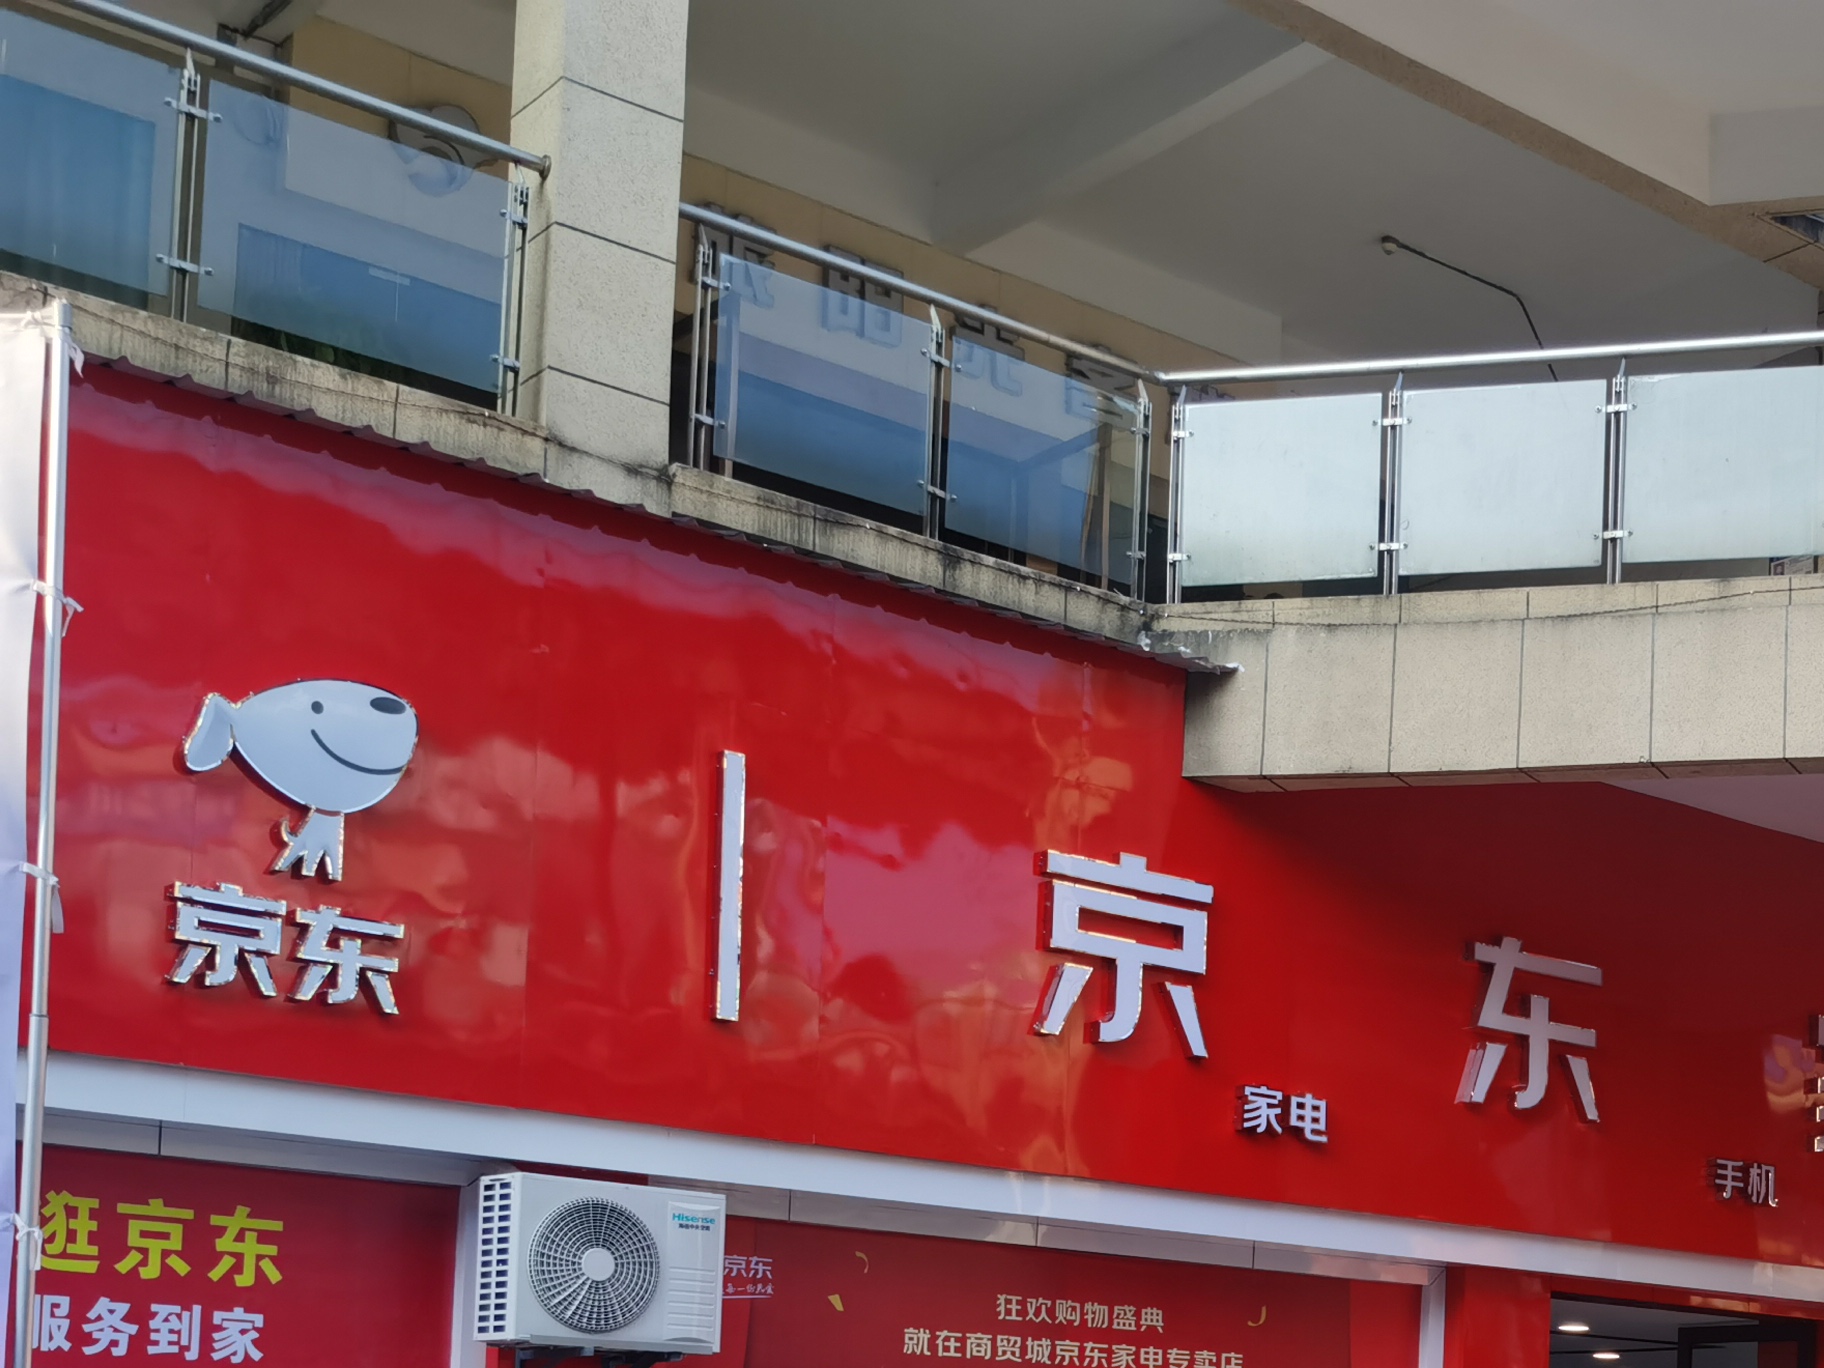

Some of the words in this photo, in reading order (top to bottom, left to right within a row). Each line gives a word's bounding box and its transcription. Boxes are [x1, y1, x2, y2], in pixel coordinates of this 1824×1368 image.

[166, 881, 405, 1015] 京东
[1238, 1084, 1329, 1144] 家电
[1712, 1158, 1779, 1208] 手机
[38, 1190, 285, 1288] 逛京东
[672, 1212, 717, 1225] Hisense
[723, 1254, 773, 1280] 京东
[29, 1294, 267, 1364] 服务到家
[996, 1293, 1165, 1333] 狂欢购物盛典
